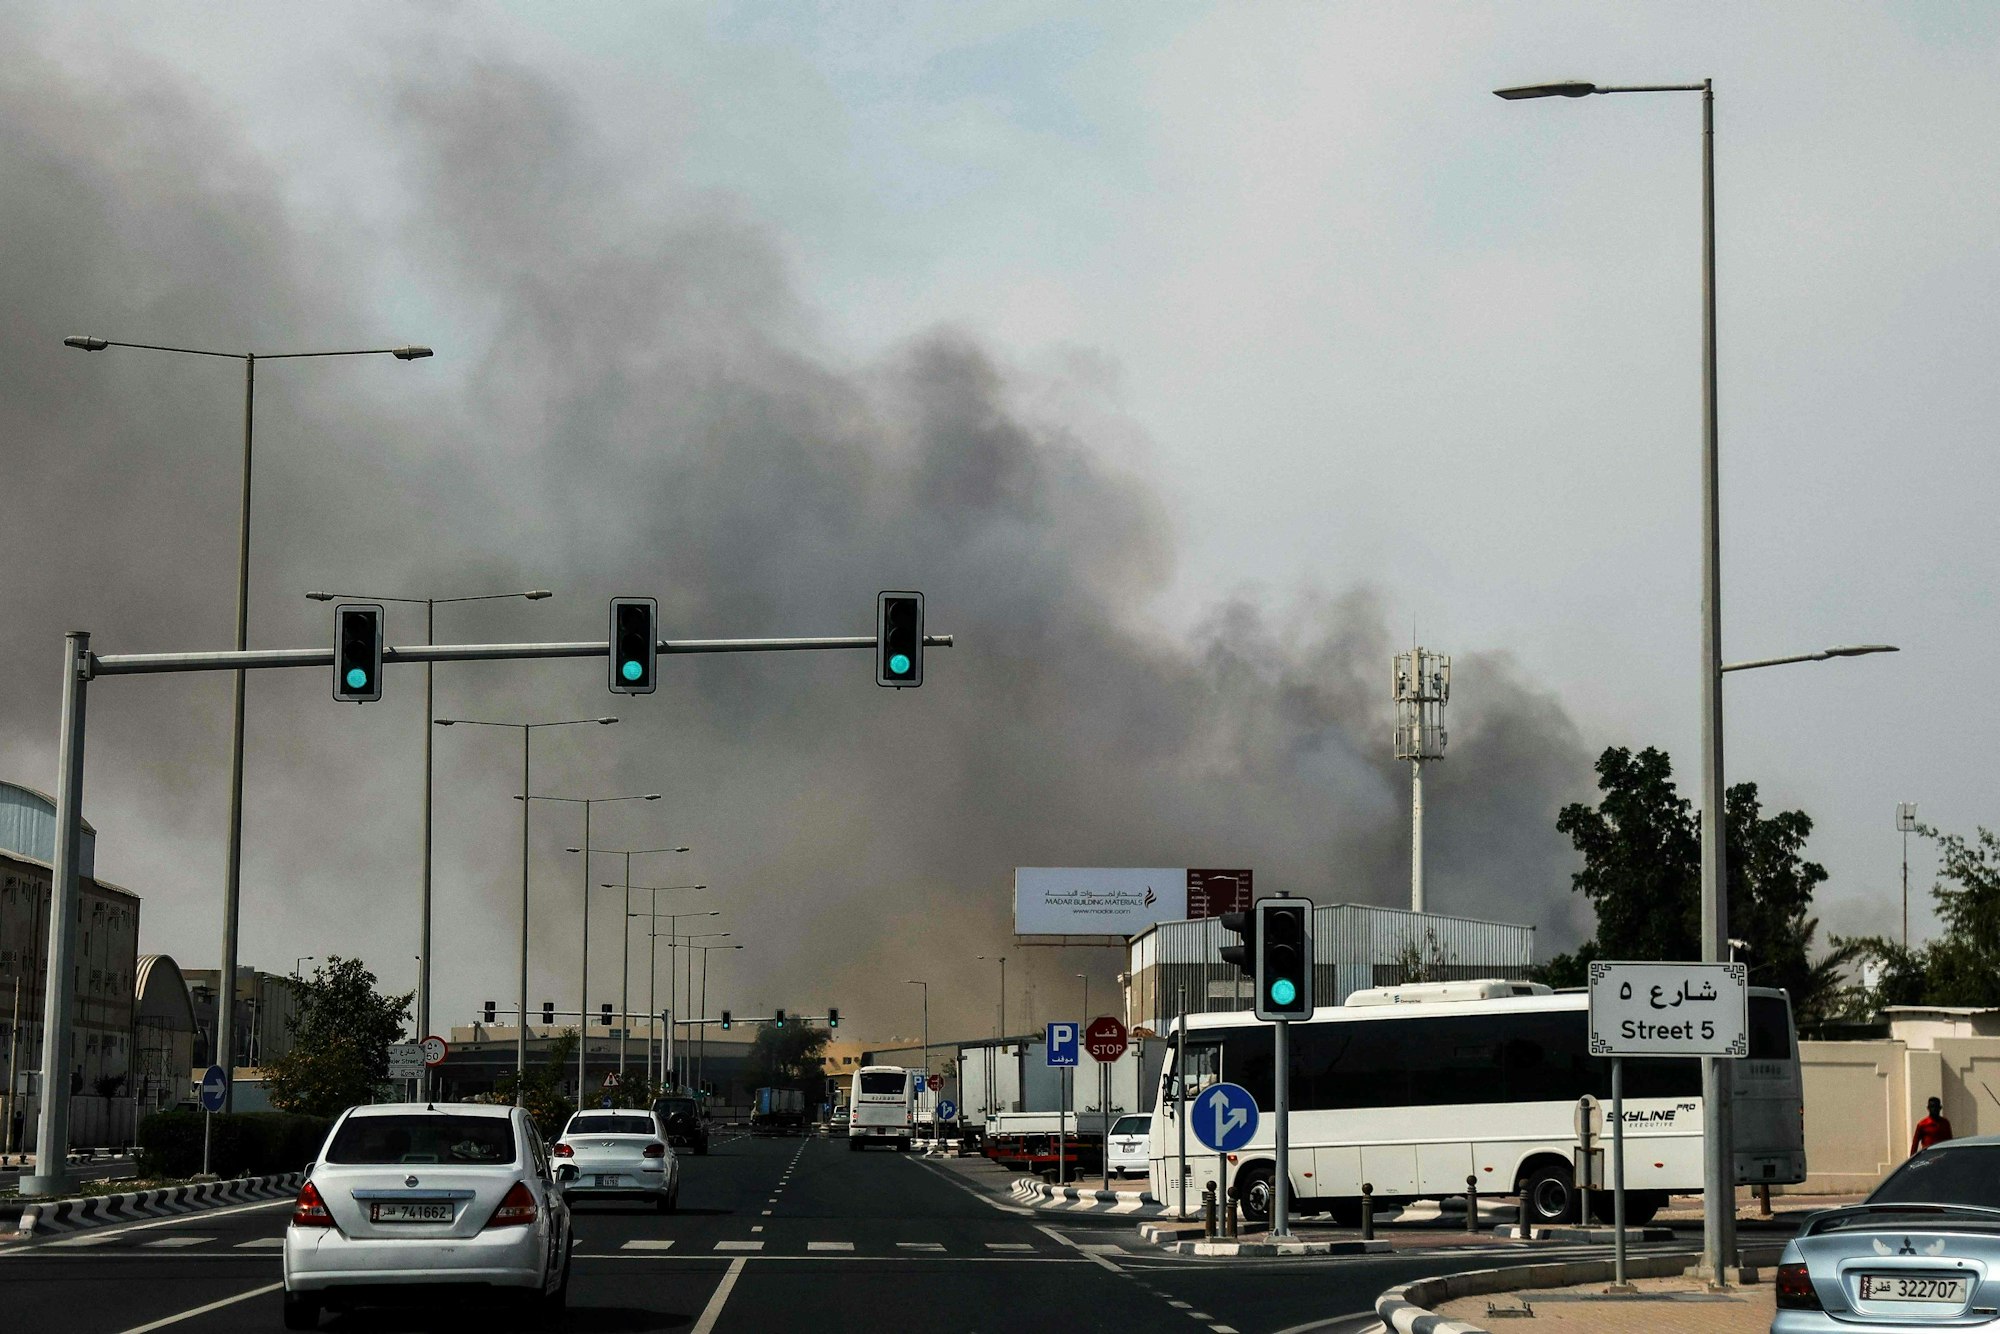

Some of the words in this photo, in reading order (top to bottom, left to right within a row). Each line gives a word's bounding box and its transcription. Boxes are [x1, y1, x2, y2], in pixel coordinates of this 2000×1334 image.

[1620, 981, 1632, 1000] ٥
[1650, 979, 1717, 1009] شارع
[1094, 1025, 1118, 1037] قف
[1621, 1020, 1693, 1040] Street
[1701, 1021, 1715, 1040] 5
[1053, 1025, 1073, 1052] P
[426, 1052, 439, 1060] 50
[1092, 1044, 1123, 1055] STOP
[1051, 1055, 1074, 1064] موقف
[1676, 1103, 1696, 1112] PRO
[401, 1206, 446, 1219] 741662
[1871, 1281, 1891, 1295] قطر
[1898, 1279, 1958, 1299] 322707
